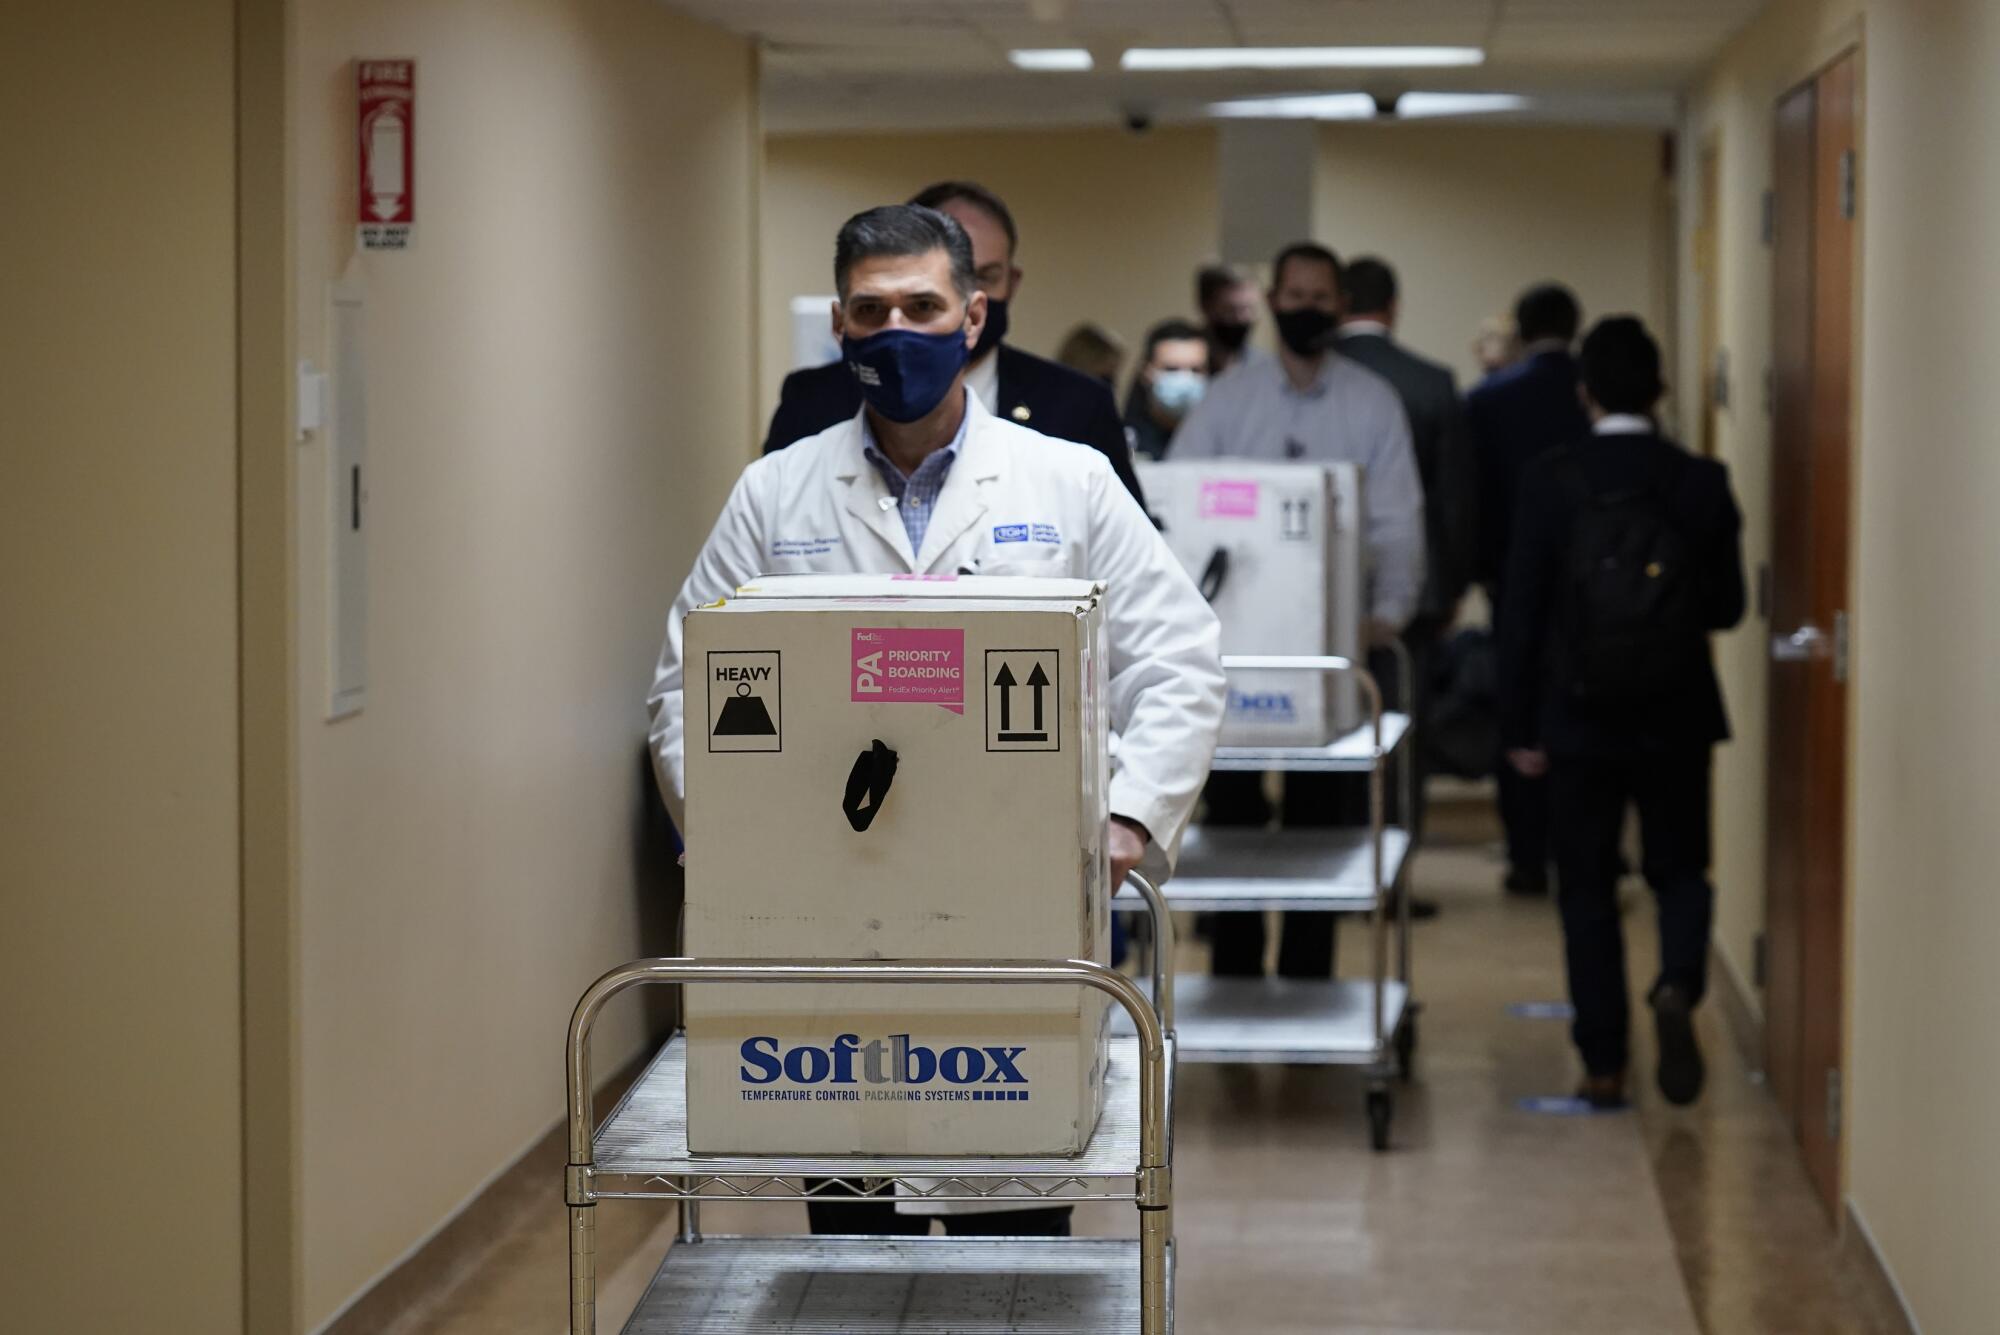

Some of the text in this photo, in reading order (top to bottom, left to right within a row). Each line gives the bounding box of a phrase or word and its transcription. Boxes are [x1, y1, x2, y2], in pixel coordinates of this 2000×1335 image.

[362, 65, 408, 80] FIRE
[888, 650, 951, 662] PRIORITY
[716, 667, 771, 681] HEAVY
[856, 650, 883, 693] PA
[888, 667, 960, 679] BOARDING
[911, 686, 937, 695] Priority
[740, 1033, 1029, 1084] Softbox
[742, 1090, 970, 1101] TEMPERATURE CONTROL PACKAGING SYSTEMS
